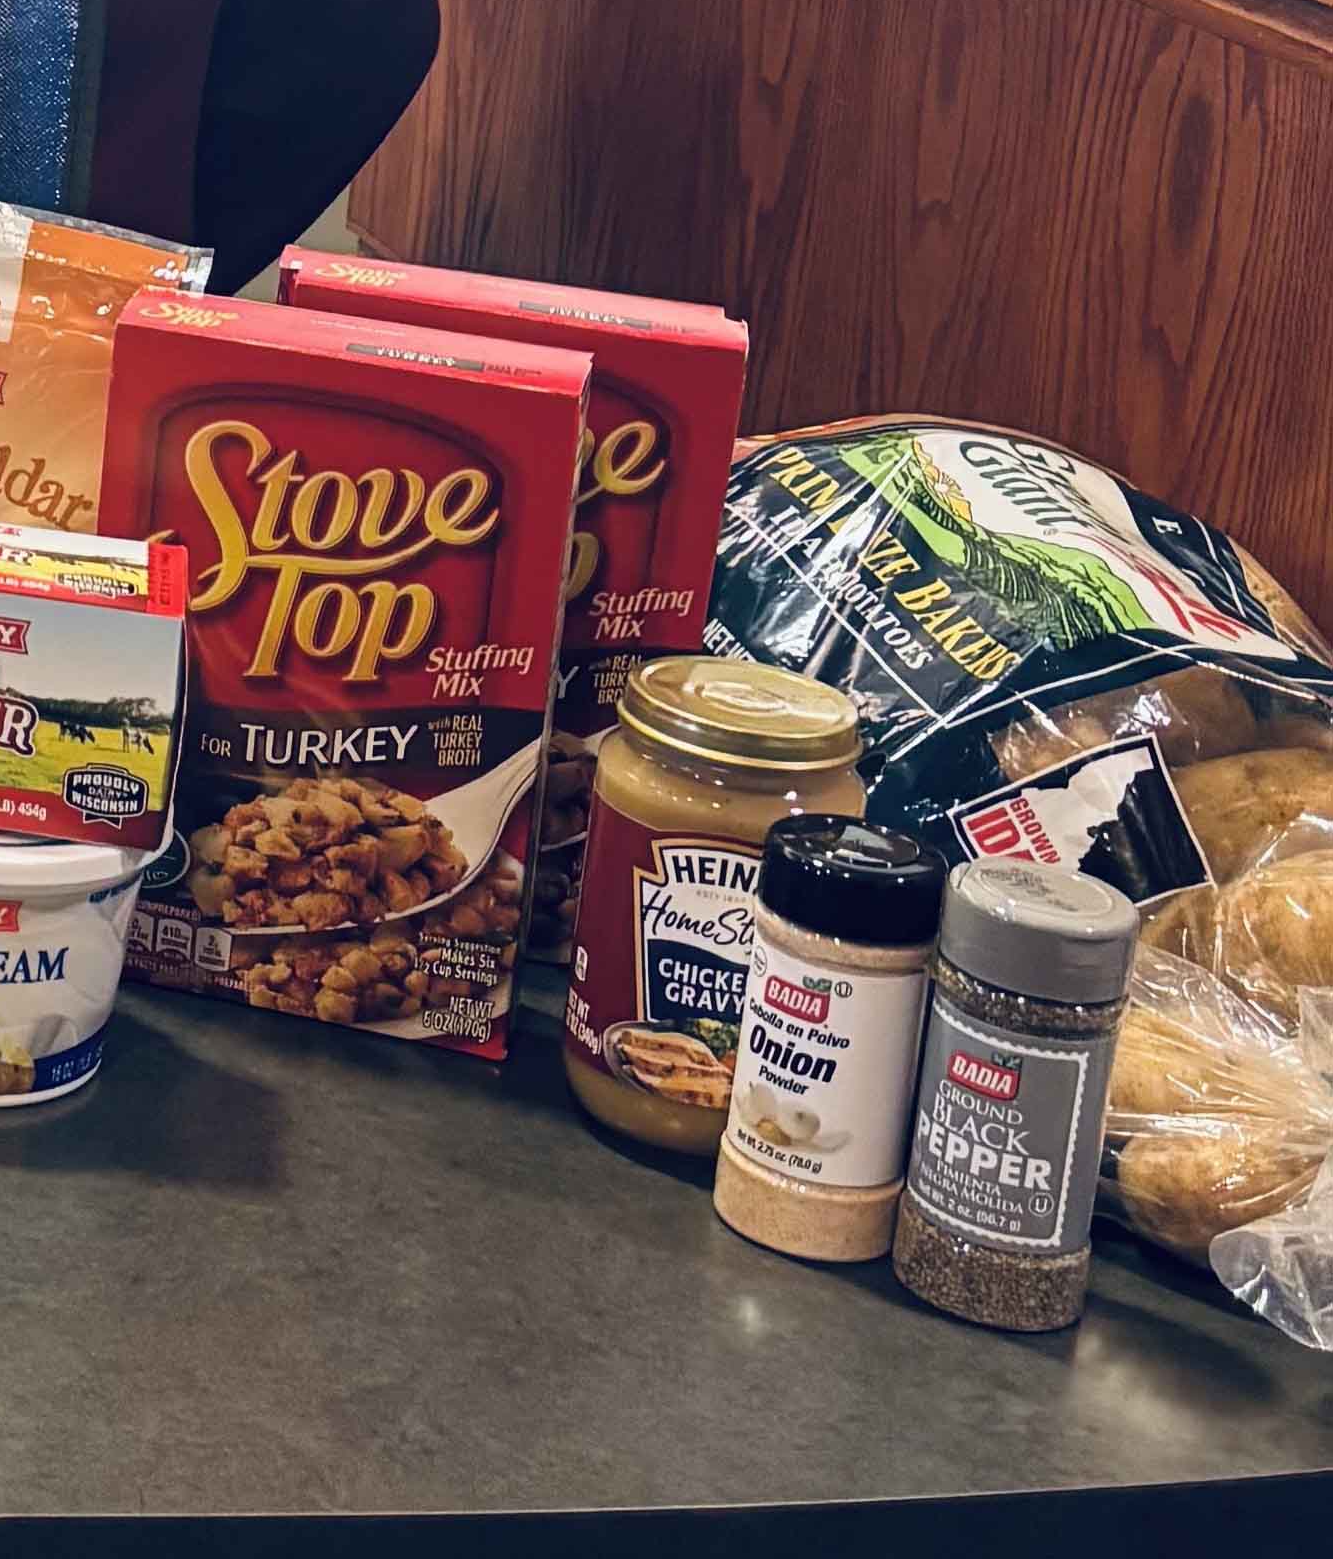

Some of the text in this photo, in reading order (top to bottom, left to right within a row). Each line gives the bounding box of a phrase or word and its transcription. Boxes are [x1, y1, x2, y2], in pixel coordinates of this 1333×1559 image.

[960, 441, 1090, 530] Giant
[184, 419, 501, 612] Stove
[589, 587, 694, 619] Stuffing
[240, 557, 436, 685] Top
[596, 615, 645, 641] Mix
[894, 577, 1024, 681] BAKERS
[424, 643, 535, 677] Stuffing
[431, 672, 485, 699] Mix
[593, 672, 628, 688] TURK
[452, 714, 484, 731] REAL
[200, 722, 419, 767] FOR TURKEY
[433, 732, 484, 750] TURKEY
[437, 748, 482, 768] BROTH
[72, 773, 140, 795] PROUDLY
[17, 801, 48, 821] 454g
[71, 790, 139, 814] WISCONSIN
[1009, 797, 1062, 866] GROWN
[672, 854, 757, 894] HEIN
[642, 889, 755, 949] HomeSt
[432, 960, 498, 987] Cup Servings
[440, 949, 497, 969] Makes Six
[657, 956, 745, 992] CHICKE
[449, 995, 496, 1018] NET WT
[665, 983, 746, 1015] GRAVY
[767, 979, 823, 1019] BADIA
[749, 997, 851, 1050] Cebolla en Polvo
[749, 1024, 838, 1083] Onion
[758, 1064, 810, 1096] Powder
[949, 1052, 1014, 1095] BADIA
[939, 1079, 1024, 1126] GROUND
[933, 1092, 1032, 1156] BLACK
[917, 1109, 1052, 1192] PEPPER
[935, 1159, 1002, 1197] PIMIENTA
[958, 1184, 1024, 1215] MOLIDA
